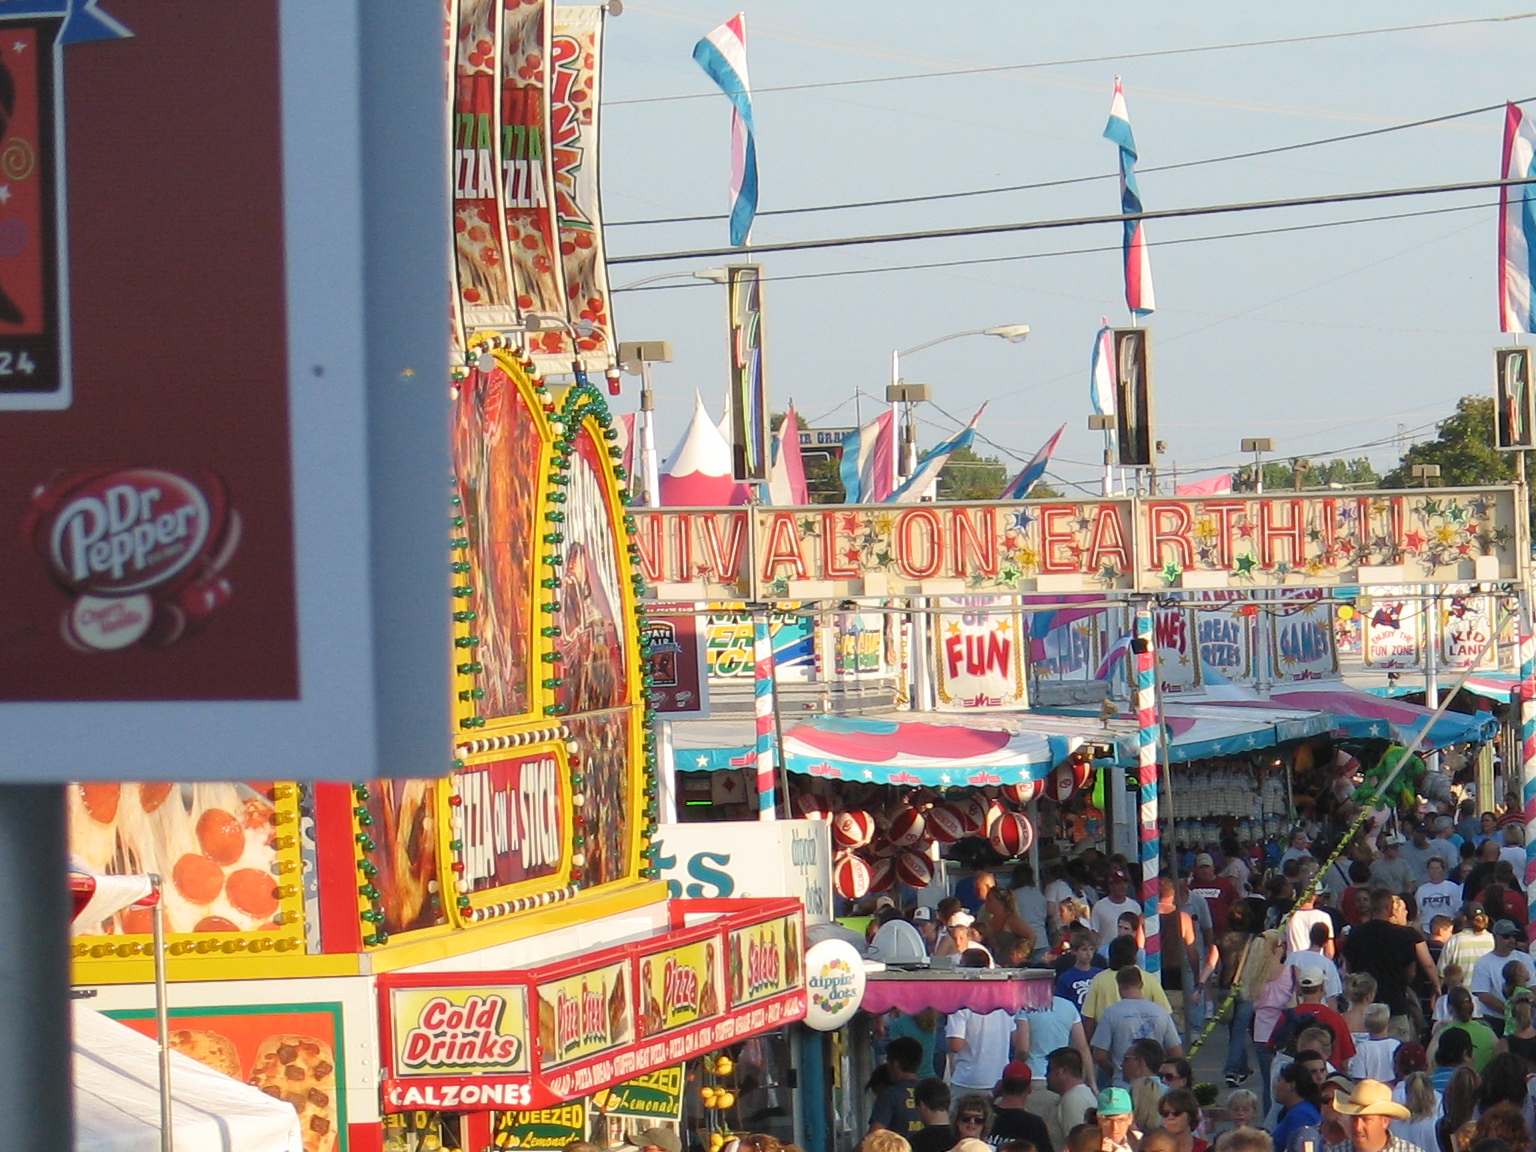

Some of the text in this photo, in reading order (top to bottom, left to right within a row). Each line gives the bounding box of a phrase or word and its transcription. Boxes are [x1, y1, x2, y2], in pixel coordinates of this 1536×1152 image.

[106, 485, 161, 533] Dr
[70, 498, 199, 582] Pepper
[895, 506, 1000, 581] ON
[1371, 629, 1396, 645] ENJOY
[1371, 645, 1415, 656] FUN ZONE
[1450, 629, 1486, 645] KID
[945, 631, 1012, 681] FUN
[520, 758, 559, 870] STICK
[664, 953, 698, 1022] Pizza
[808, 973, 855, 993] dippin'
[828, 984, 858, 1001] dots
[421, 996, 501, 1031] Cold
[404, 1031, 516, 1063] Drinks
[390, 1083, 531, 1106] CALZONES
[620, 1089, 680, 1115] Lemonade
